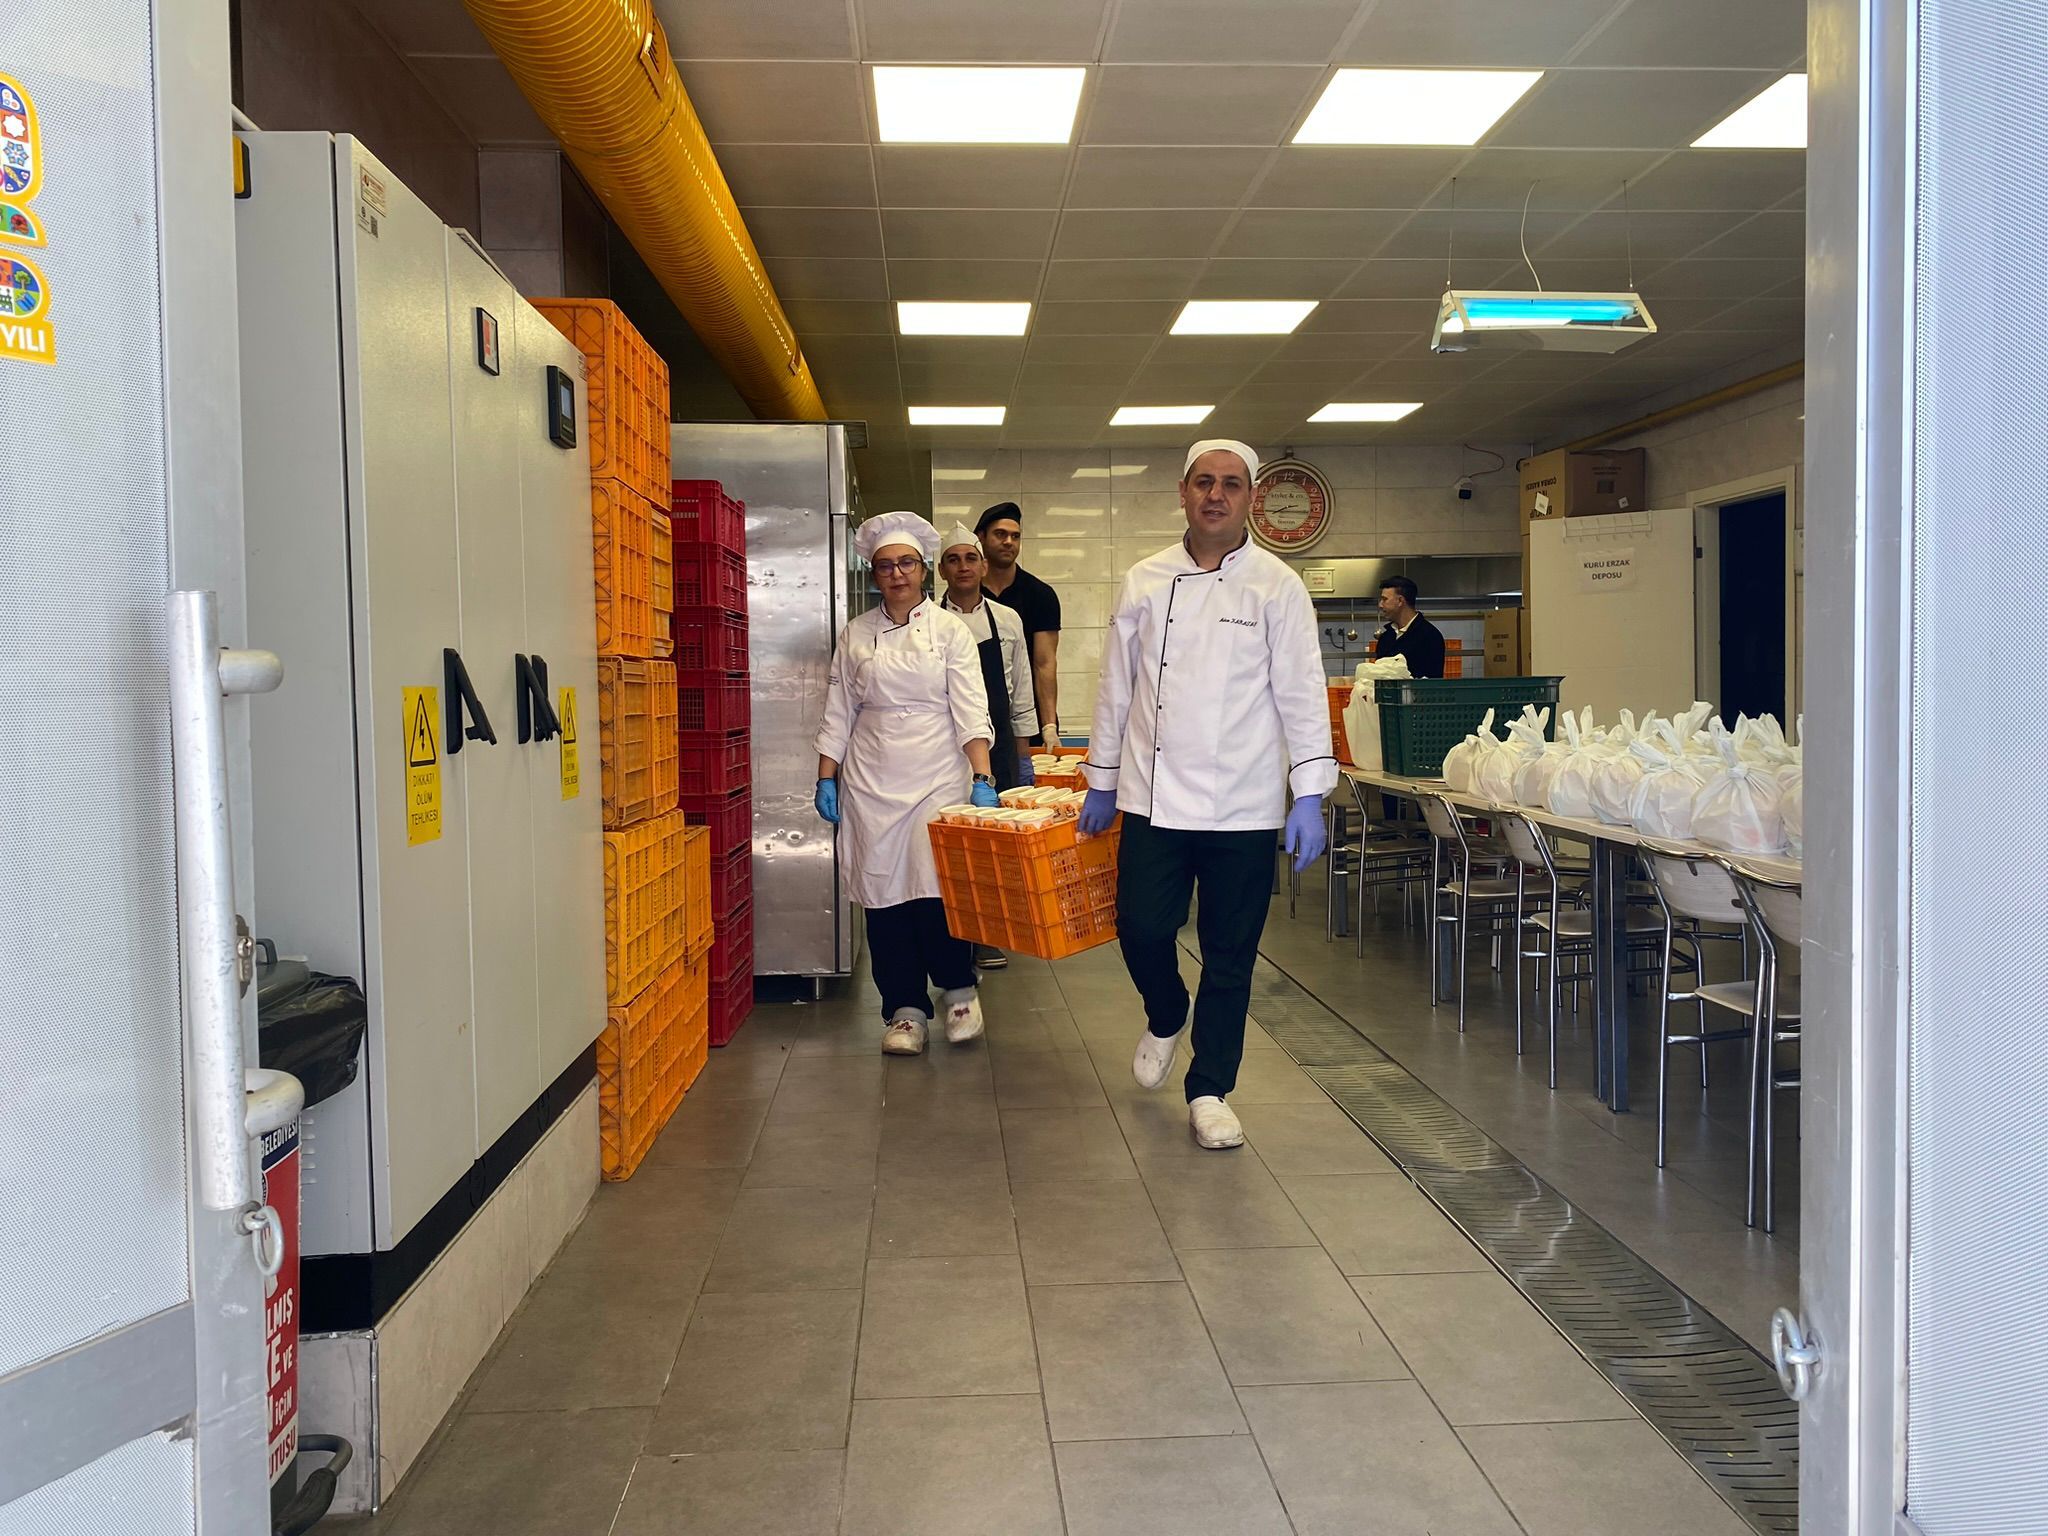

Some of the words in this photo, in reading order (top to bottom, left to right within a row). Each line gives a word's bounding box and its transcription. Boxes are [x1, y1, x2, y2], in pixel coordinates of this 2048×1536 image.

[0, 323, 46, 353] YILI
[1584, 561, 1605, 569] KURU
[1606, 559, 1631, 568] ERZAK
[1591, 571, 1622, 580] DEPOSU
[283, 1344, 293, 1374] VE
